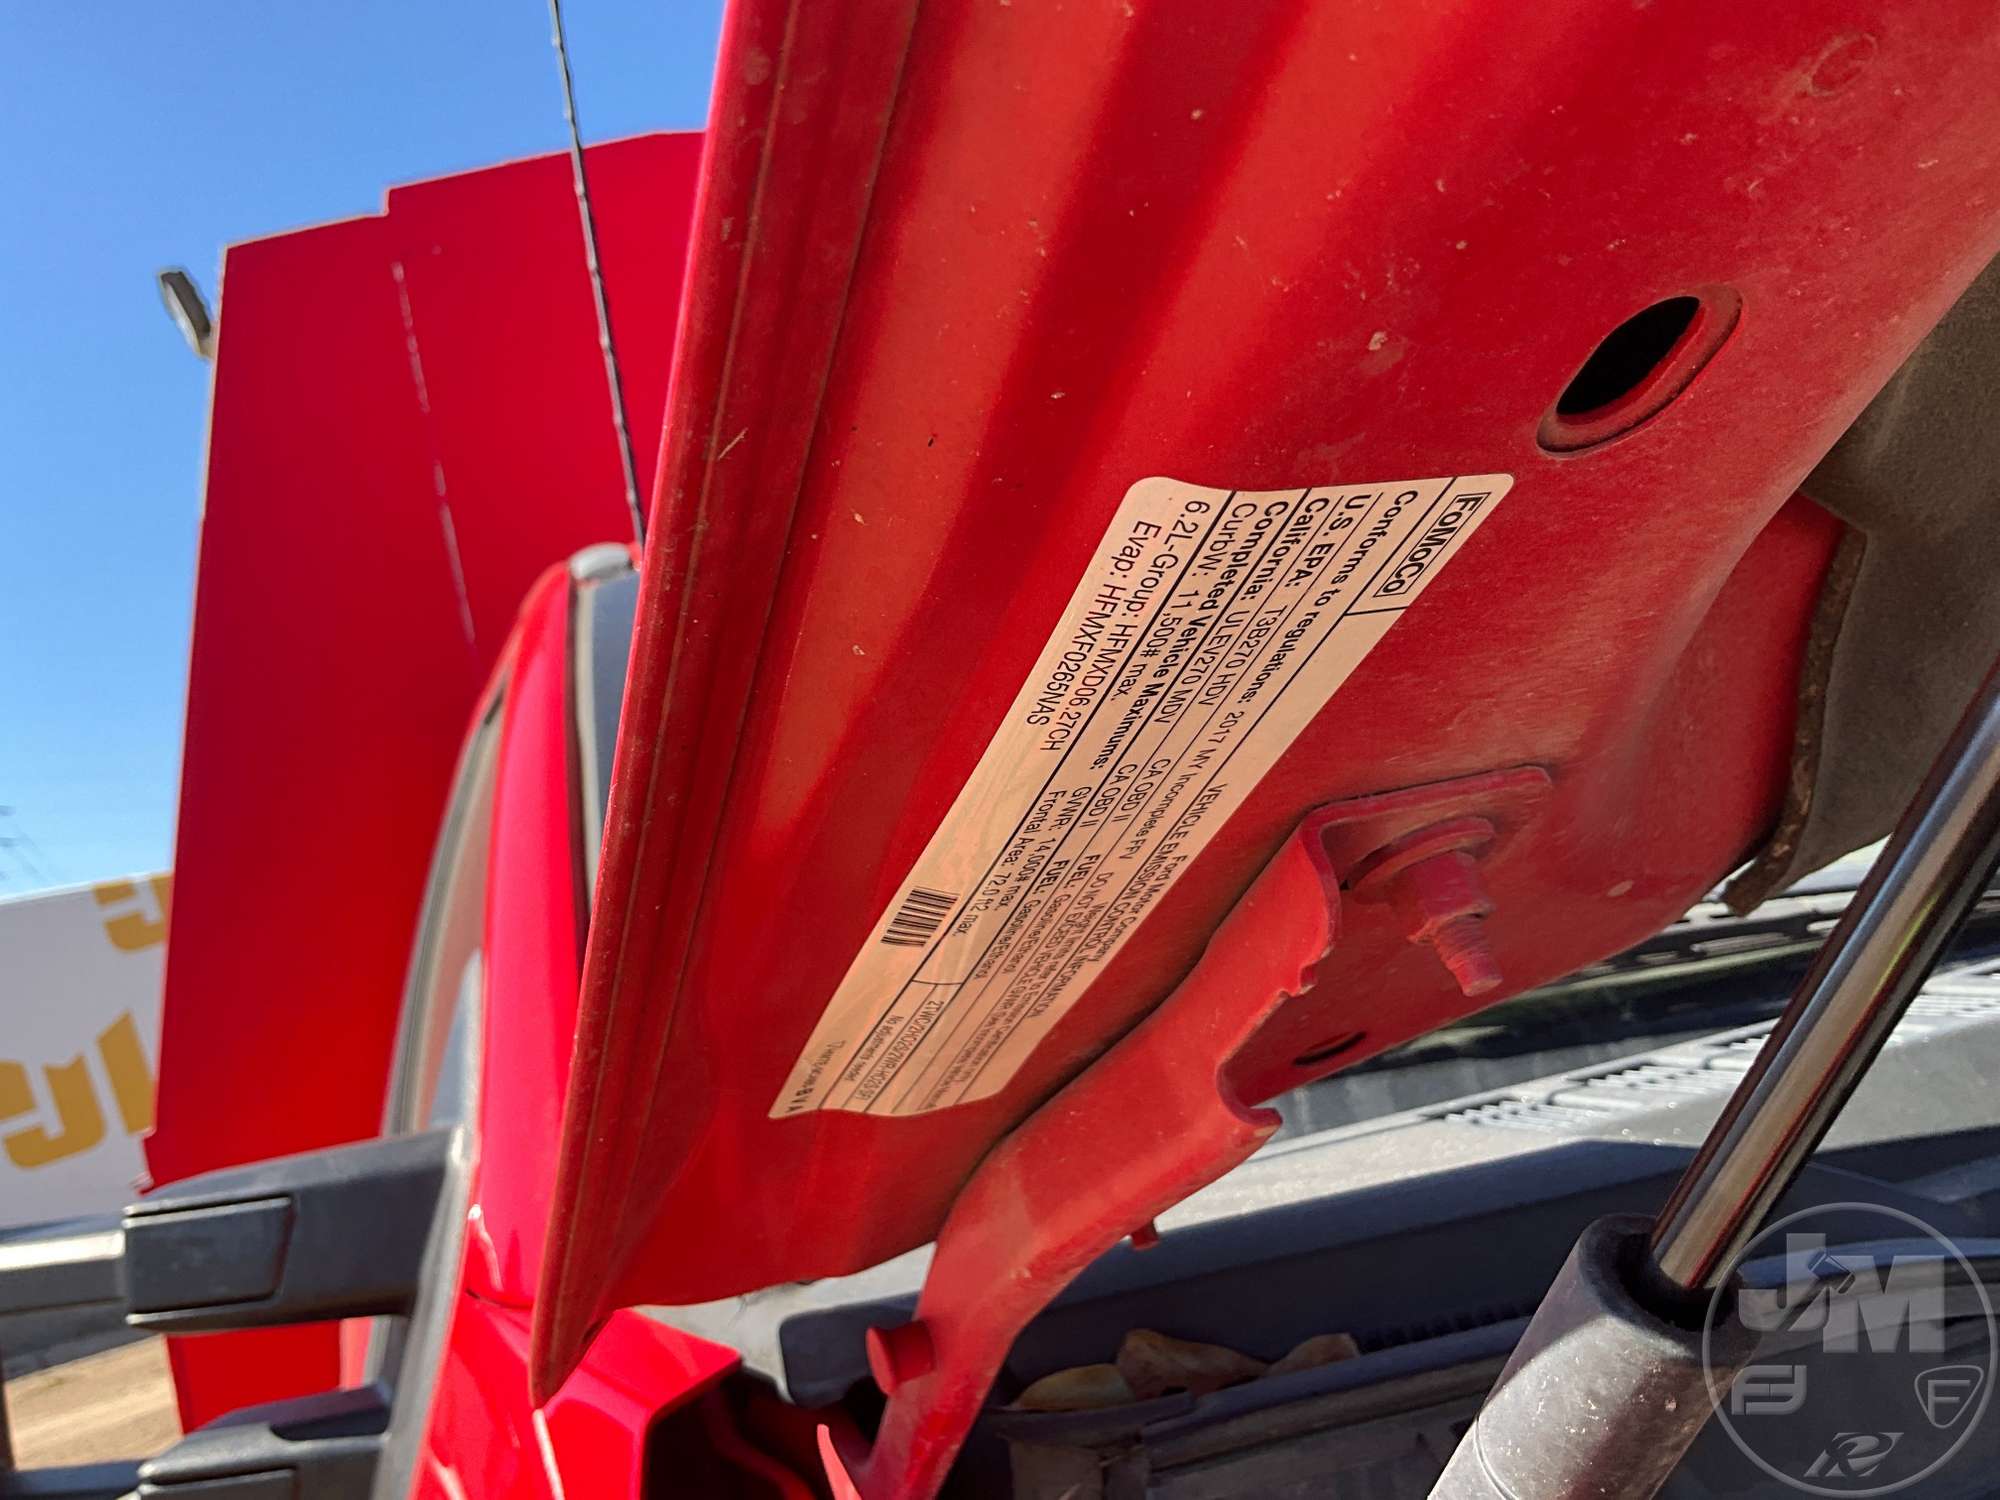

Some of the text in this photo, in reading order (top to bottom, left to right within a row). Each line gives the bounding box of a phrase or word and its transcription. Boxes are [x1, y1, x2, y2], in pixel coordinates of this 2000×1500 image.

[1321, 494, 1372, 536] U.S.
[1238, 497, 1331, 600] California:
[1283, 542, 1335, 587] EPA:
[1380, 496, 1483, 593] FoMoCo
[1023, 519, 1165, 725] Evap: HFMXF0265NAS
[1109, 502, 1259, 701] CurbW: 11,500# max.
[1038, 500, 1213, 751] 6.2L-Group: HFMXD06.27CH
[1088, 500, 1290, 770] Completed Vehicle Maximums:
[1179, 610, 1250, 684] ULEV270
[1223, 604, 1288, 669] T3B270
[1117, 490, 1420, 859] Conforms to regulations: 2017 MY Incomplete FFV
[1196, 672, 1236, 706] HDV
[1152, 688, 1193, 724] MDV
[1108, 763, 1139, 785] CA
[1141, 758, 1172, 779] CA
[1022, 789, 1068, 833] Frontal
[1086, 786, 1122, 817] OBD
[1110, 814, 1131, 822] II
[1119, 781, 1154, 811] OBD
[1167, 783, 1228, 840] VEHICLE
[1078, 819, 1099, 828] II
[992, 786, 1093, 911] GVWR: 14,000# max.
[1000, 836, 1035, 866] Area:
[1062, 854, 1101, 888] FUEL:
[1120, 841, 1180, 900] EMISSION
[980, 871, 1012, 896] 72.0
[1031, 859, 1070, 894] FUEL:
[1077, 901, 1132, 953] CONTROL
[1085, 854, 1188, 962] Ford Motor Company
